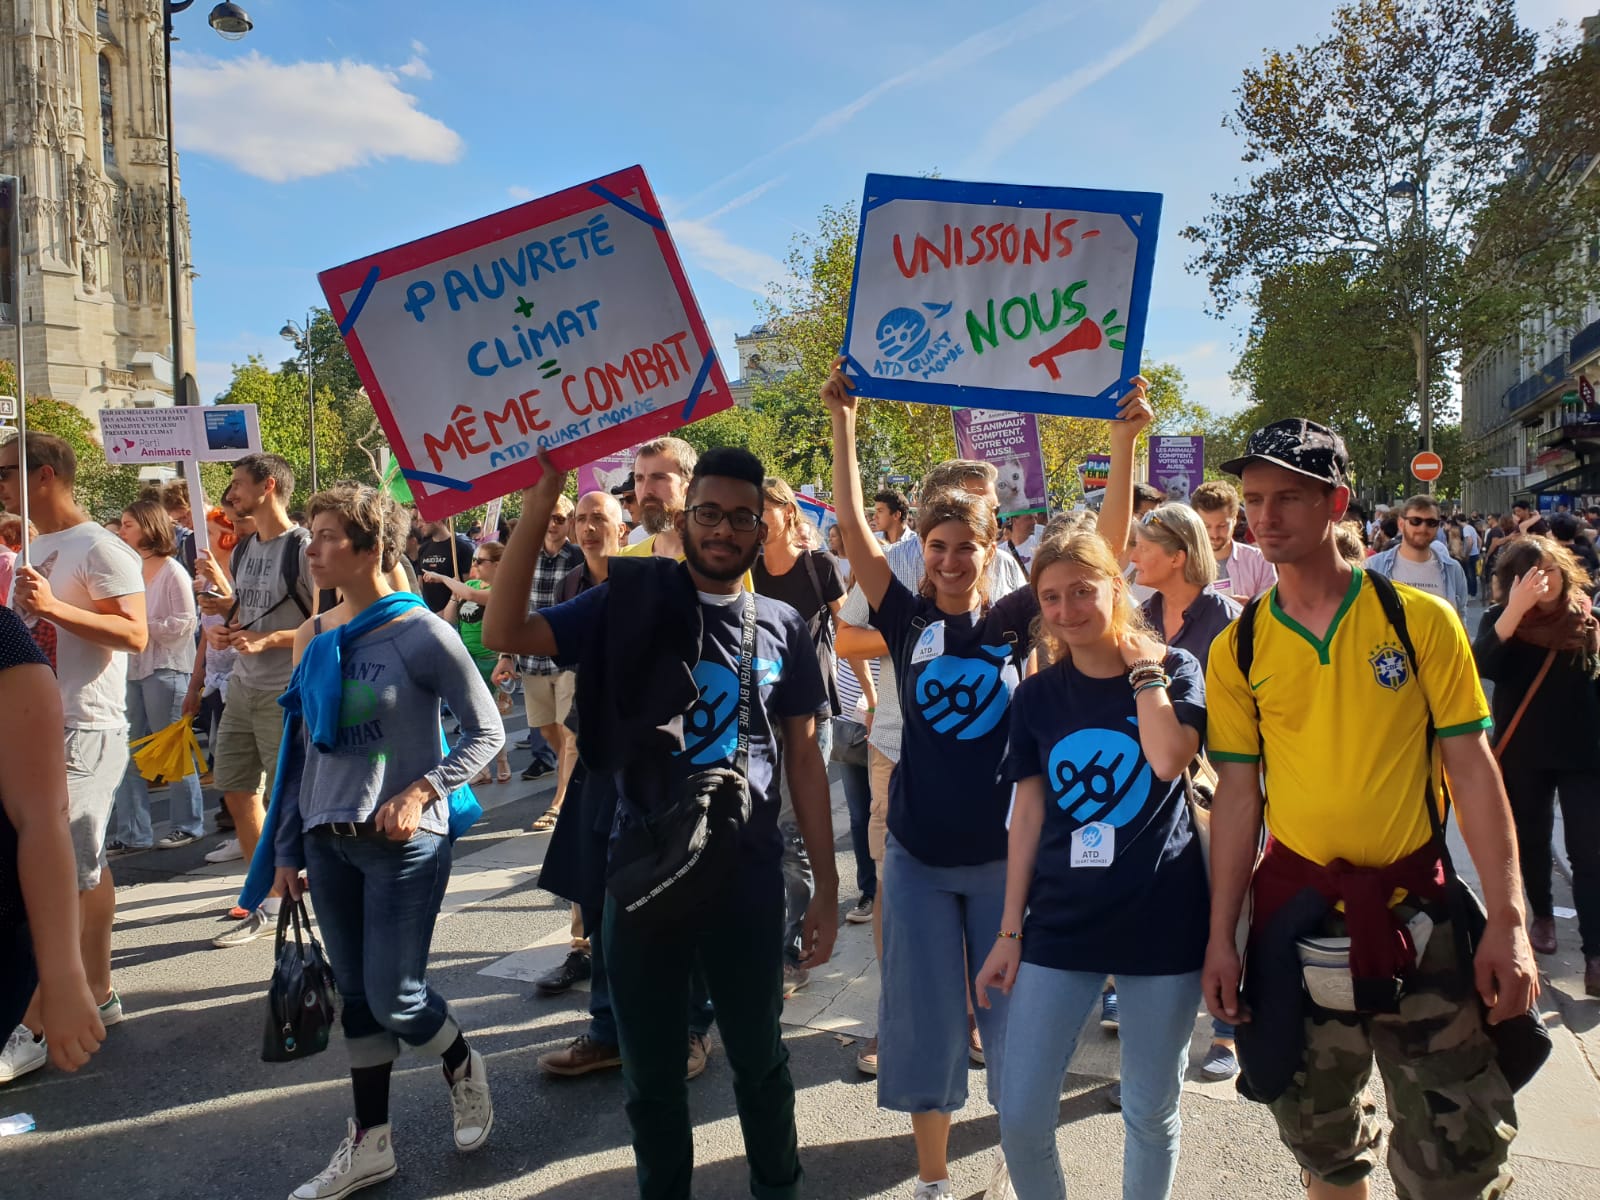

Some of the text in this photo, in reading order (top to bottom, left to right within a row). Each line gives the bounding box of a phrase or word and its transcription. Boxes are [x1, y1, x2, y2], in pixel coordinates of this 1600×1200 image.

[893, 212, 1100, 278] UNISSONS-
[404, 214, 614, 322] PAUVRETÉ
[514, 296, 534, 318] +
[966, 280, 1088, 355] NOUS
[467, 300, 600, 376] CLIMAT
[873, 330, 952, 378] ATD QUART
[922, 344, 965, 380] MONDE
[537, 359, 562, 379] =
[424, 331, 692, 472] MÊME COMBAT
[489, 398, 657, 467] ATD QUART MONDE
[966, 418, 1026, 434] LES ANIMAUX
[971, 427, 1023, 442] COMPTENT,
[139, 438, 160, 448] Parti
[141, 447, 192, 457] Animaliste
[971, 435, 1025, 451] VOTRE VOIX
[743, 626, 753, 647] FIRE
[740, 650, 752, 686] DRIVEN
[740, 687, 750, 703] BY
[739, 705, 749, 729] FIRE
[1082, 850, 1099, 859] ATD
